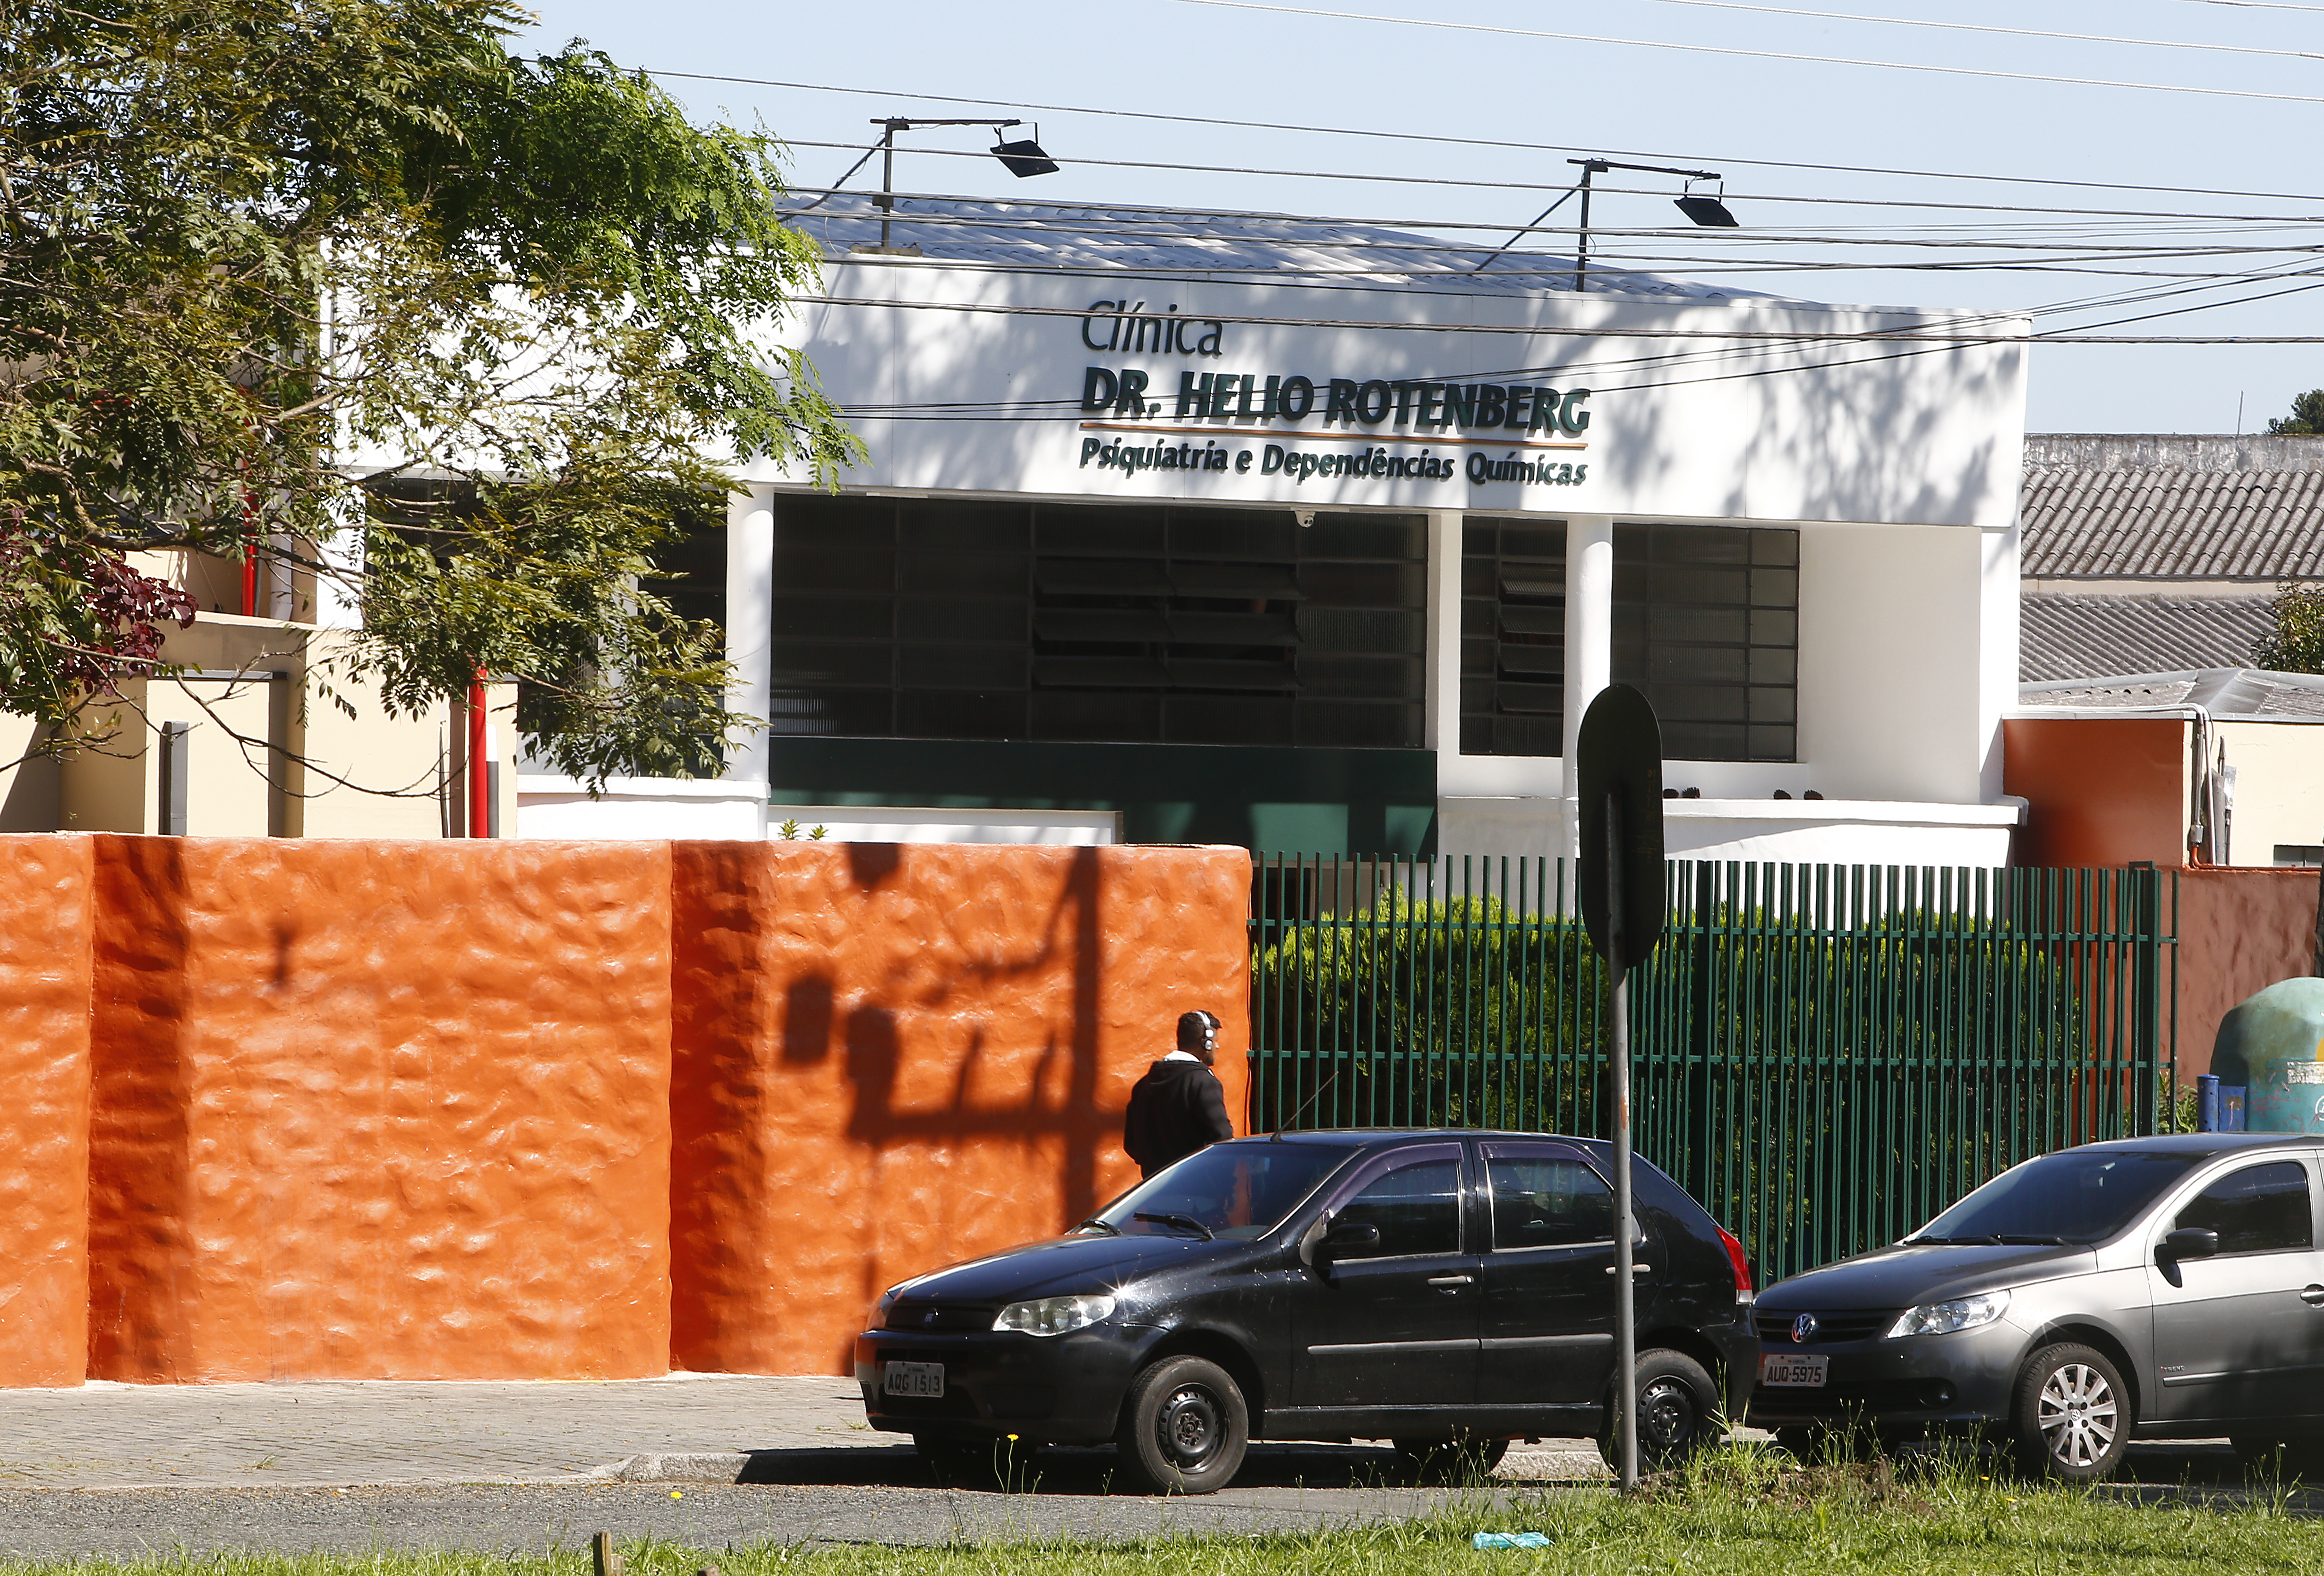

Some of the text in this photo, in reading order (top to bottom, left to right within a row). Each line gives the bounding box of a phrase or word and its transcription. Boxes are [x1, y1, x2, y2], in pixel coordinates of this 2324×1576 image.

[1082, 300, 1222, 355] Clínica
[1082, 367, 1591, 432] DR. HELIO ROTENBERG
[1080, 437, 1589, 486] Psiquiatria e Dependências Químicas
